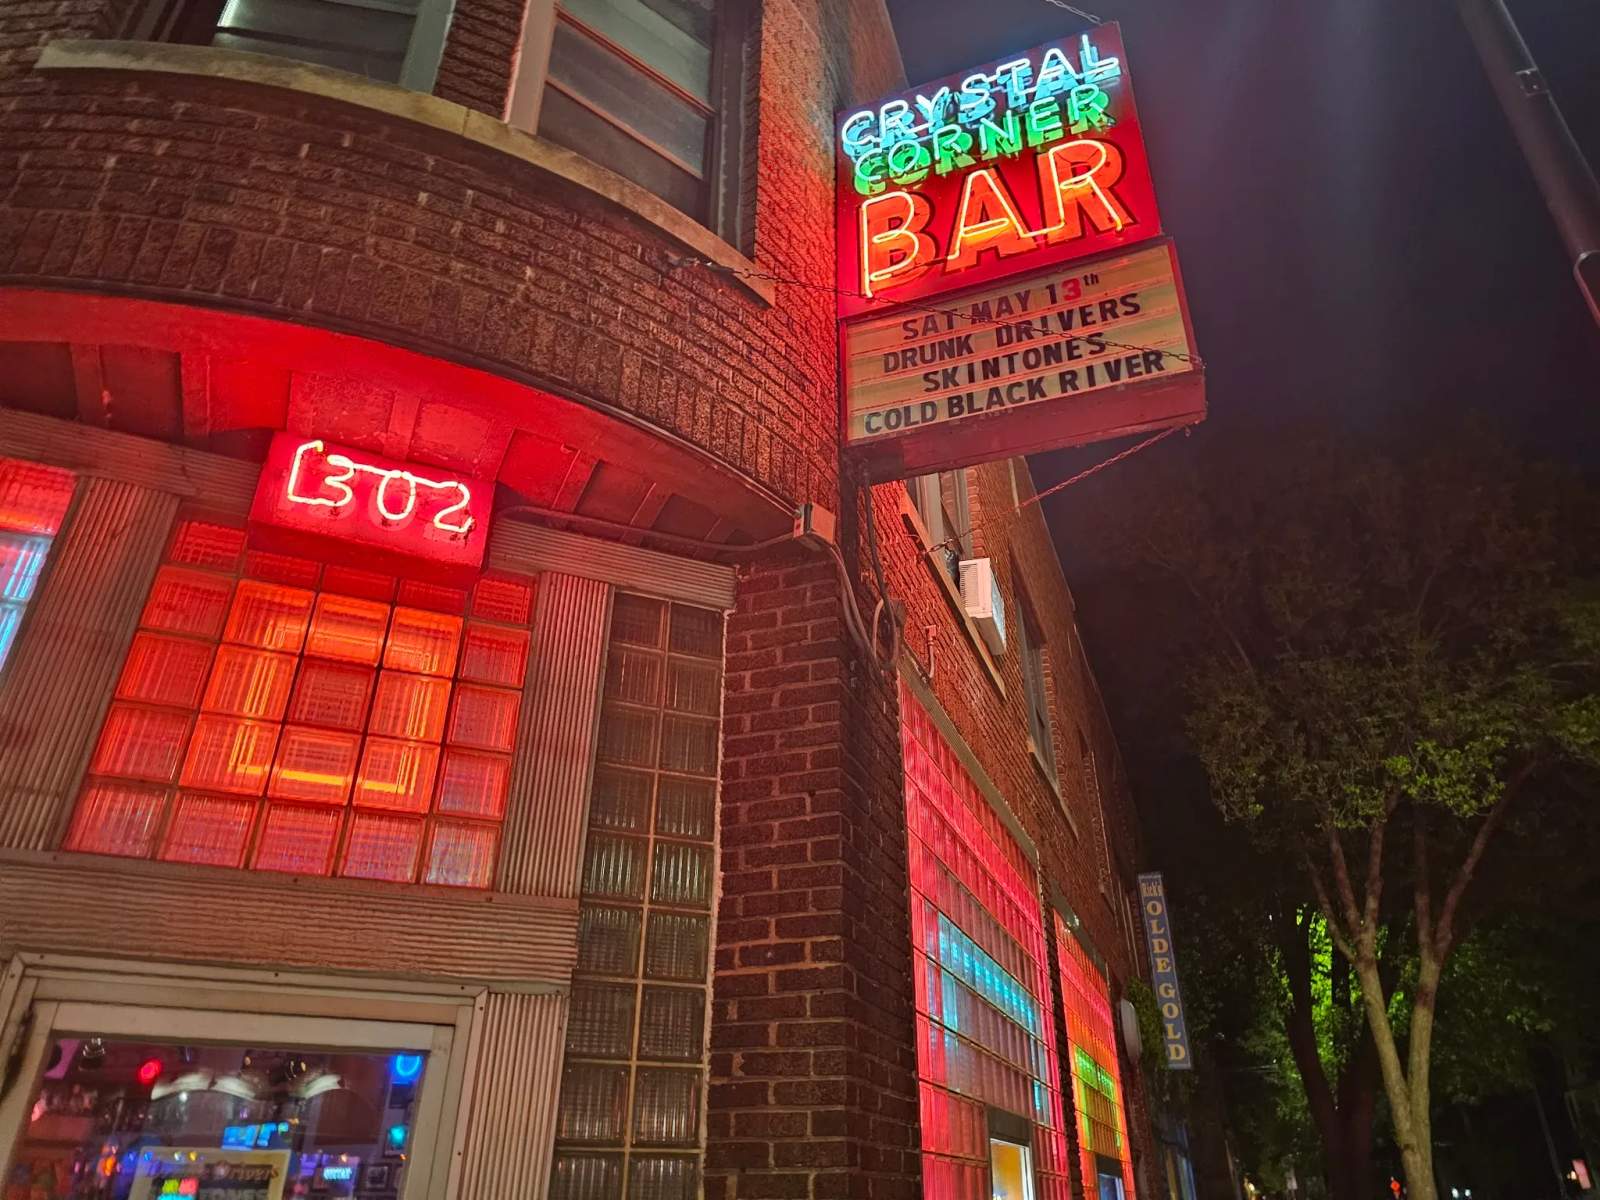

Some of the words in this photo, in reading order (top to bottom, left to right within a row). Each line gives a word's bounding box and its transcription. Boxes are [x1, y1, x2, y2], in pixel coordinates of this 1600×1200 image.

[841, 34, 1121, 160] CRYSTAL
[854, 84, 1112, 195] CORNER
[859, 139, 1133, 298] BAR
[883, 334, 975, 373] DRUNK
[996, 292, 1142, 348] DRIVERS
[902, 308, 957, 340] SAT
[971, 289, 1031, 323] MAY
[865, 401, 938, 434] COLD
[947, 376, 1047, 417] BLACK
[1060, 351, 1166, 393] RIVER
[923, 331, 1106, 393] SKINTONES
[1146, 900, 1172, 973] OLDE
[1159, 983, 1186, 1061] GOLD
